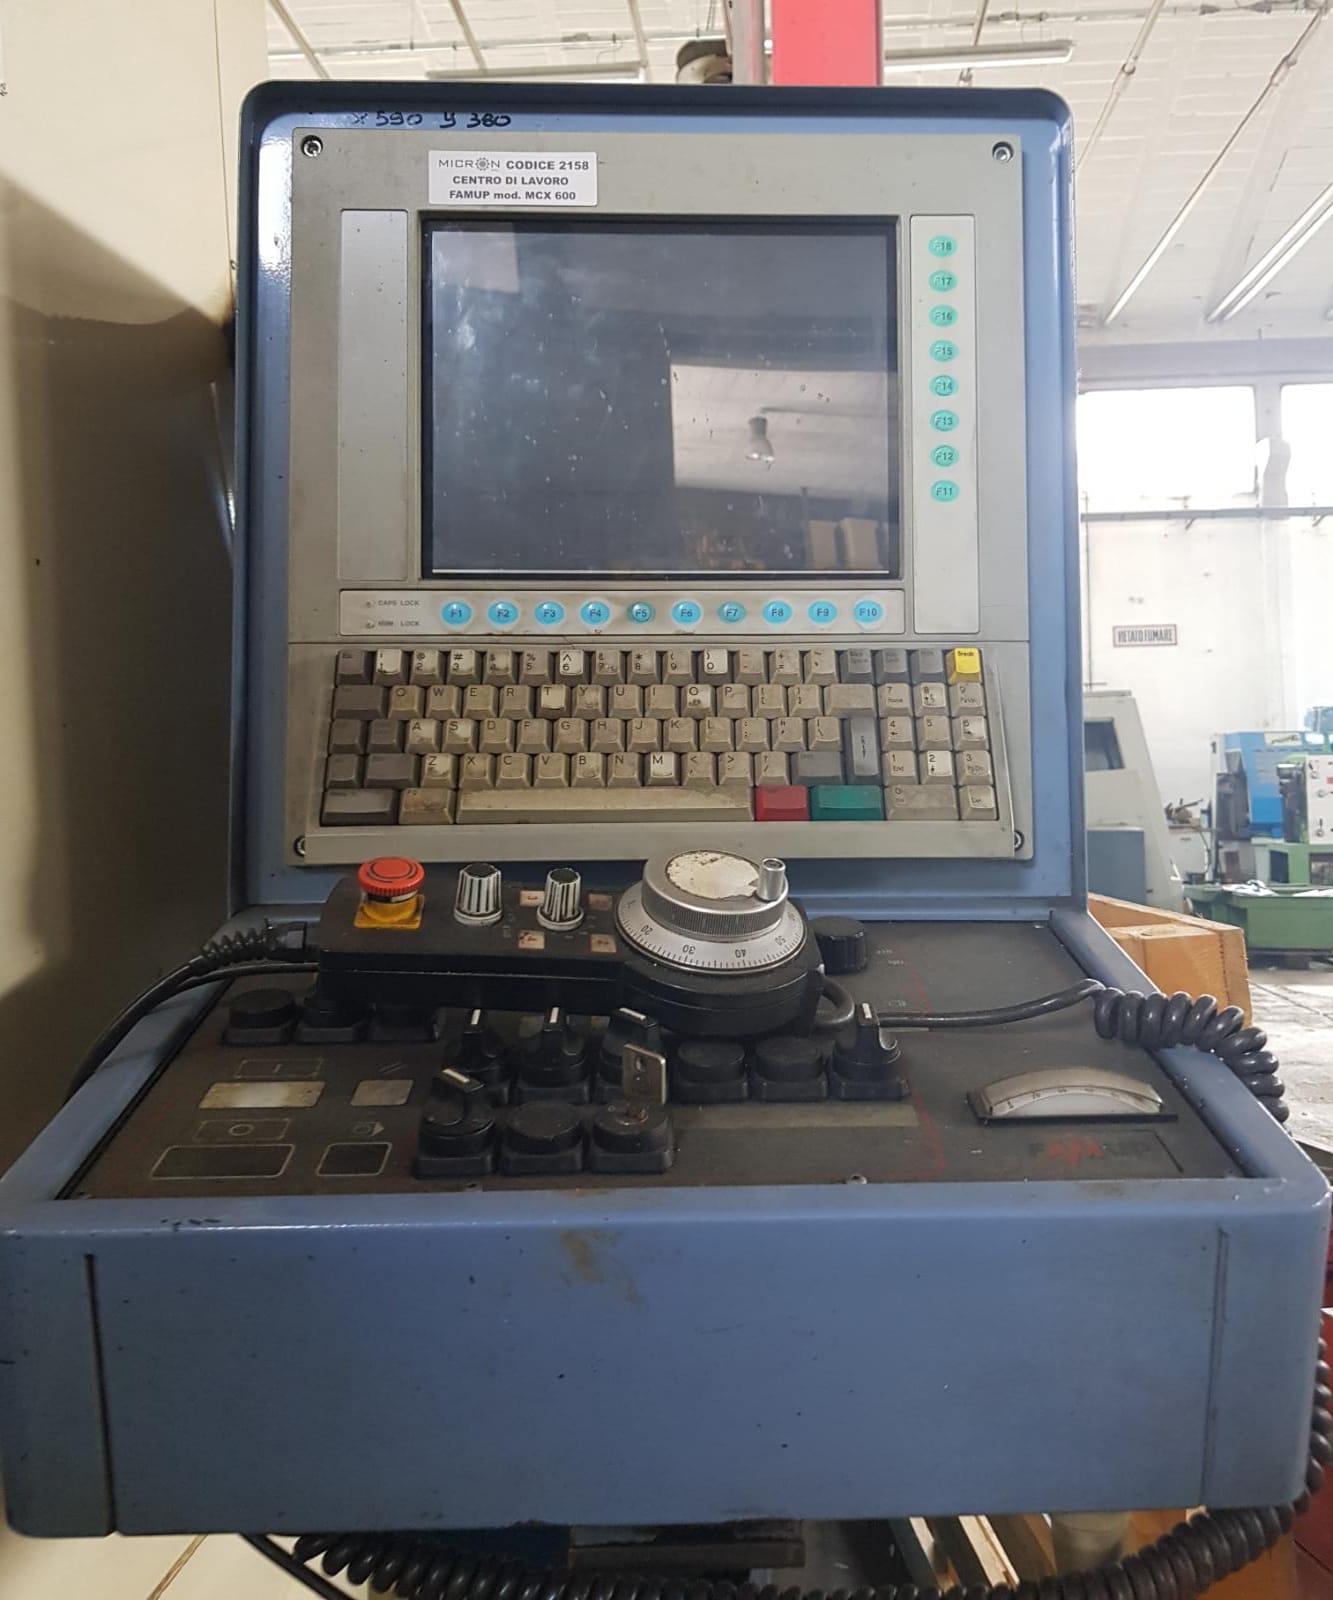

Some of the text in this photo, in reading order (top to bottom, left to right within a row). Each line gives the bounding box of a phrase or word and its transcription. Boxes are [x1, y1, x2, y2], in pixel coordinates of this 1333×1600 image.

[375, 110, 423, 127] 590
[466, 111, 511, 128] 380
[506, 160, 555, 170] CODICE
[559, 161, 589, 170] 2158
[453, 175, 569, 186] CENTRO DI LAVORO
[449, 190, 576, 200] FAMUP mod. MCX 600
[934, 241, 953, 251] F18
[934, 277, 953, 285] F17
[934, 312, 953, 321] F16
[935, 346, 953, 356] F15
[935, 382, 953, 391] F14
[935, 417, 953, 426] F13
[936, 452, 953, 461] F12
[936, 487, 953, 496] F11
[451, 609, 462, 617] F1
[497, 609, 510, 617] F2
[543, 609, 556, 617] F3
[589, 609, 602, 617] F4
[635, 608, 648, 616] F5
[680, 608, 693, 616] F6
[726, 608, 739, 616] F7
[772, 608, 784, 616] F8
[817, 608, 829, 616] F9
[859, 608, 877, 616] F10
[416, 663, 424, 671] 2
[452, 663, 460, 671] 3
[526, 663, 532, 671] 5
[563, 663, 570, 671] 6
[635, 663, 641, 671] 8
[670, 662, 677, 670] 9
[433, 687, 445, 696] W
[470, 687, 478, 696] E
[506, 687, 515, 696] R
[543, 687, 552, 696] T
[580, 687, 588, 696] Y
[616, 687, 625, 696] U
[725, 687, 732, 696] P
[412, 721, 421, 730] A
[449, 721, 458, 730] S
[487, 721, 495, 730] D
[524, 721, 532, 729] F
[561, 721, 570, 729] G
[598, 721, 607, 729] H
[635, 721, 643, 729] J
[671, 720, 679, 729] K
[707, 720, 714, 729] L
[428, 756, 438, 766] Z
[467, 756, 476, 765] X
[503, 756, 512, 765] C
[541, 755, 550, 765] V
[579, 755, 586, 764] B
[615, 755, 624, 764] N
[652, 755, 663, 764] M
[929, 754, 936, 762] 2
[682, 944, 696, 954] 30
[735, 949, 746, 958] 40
